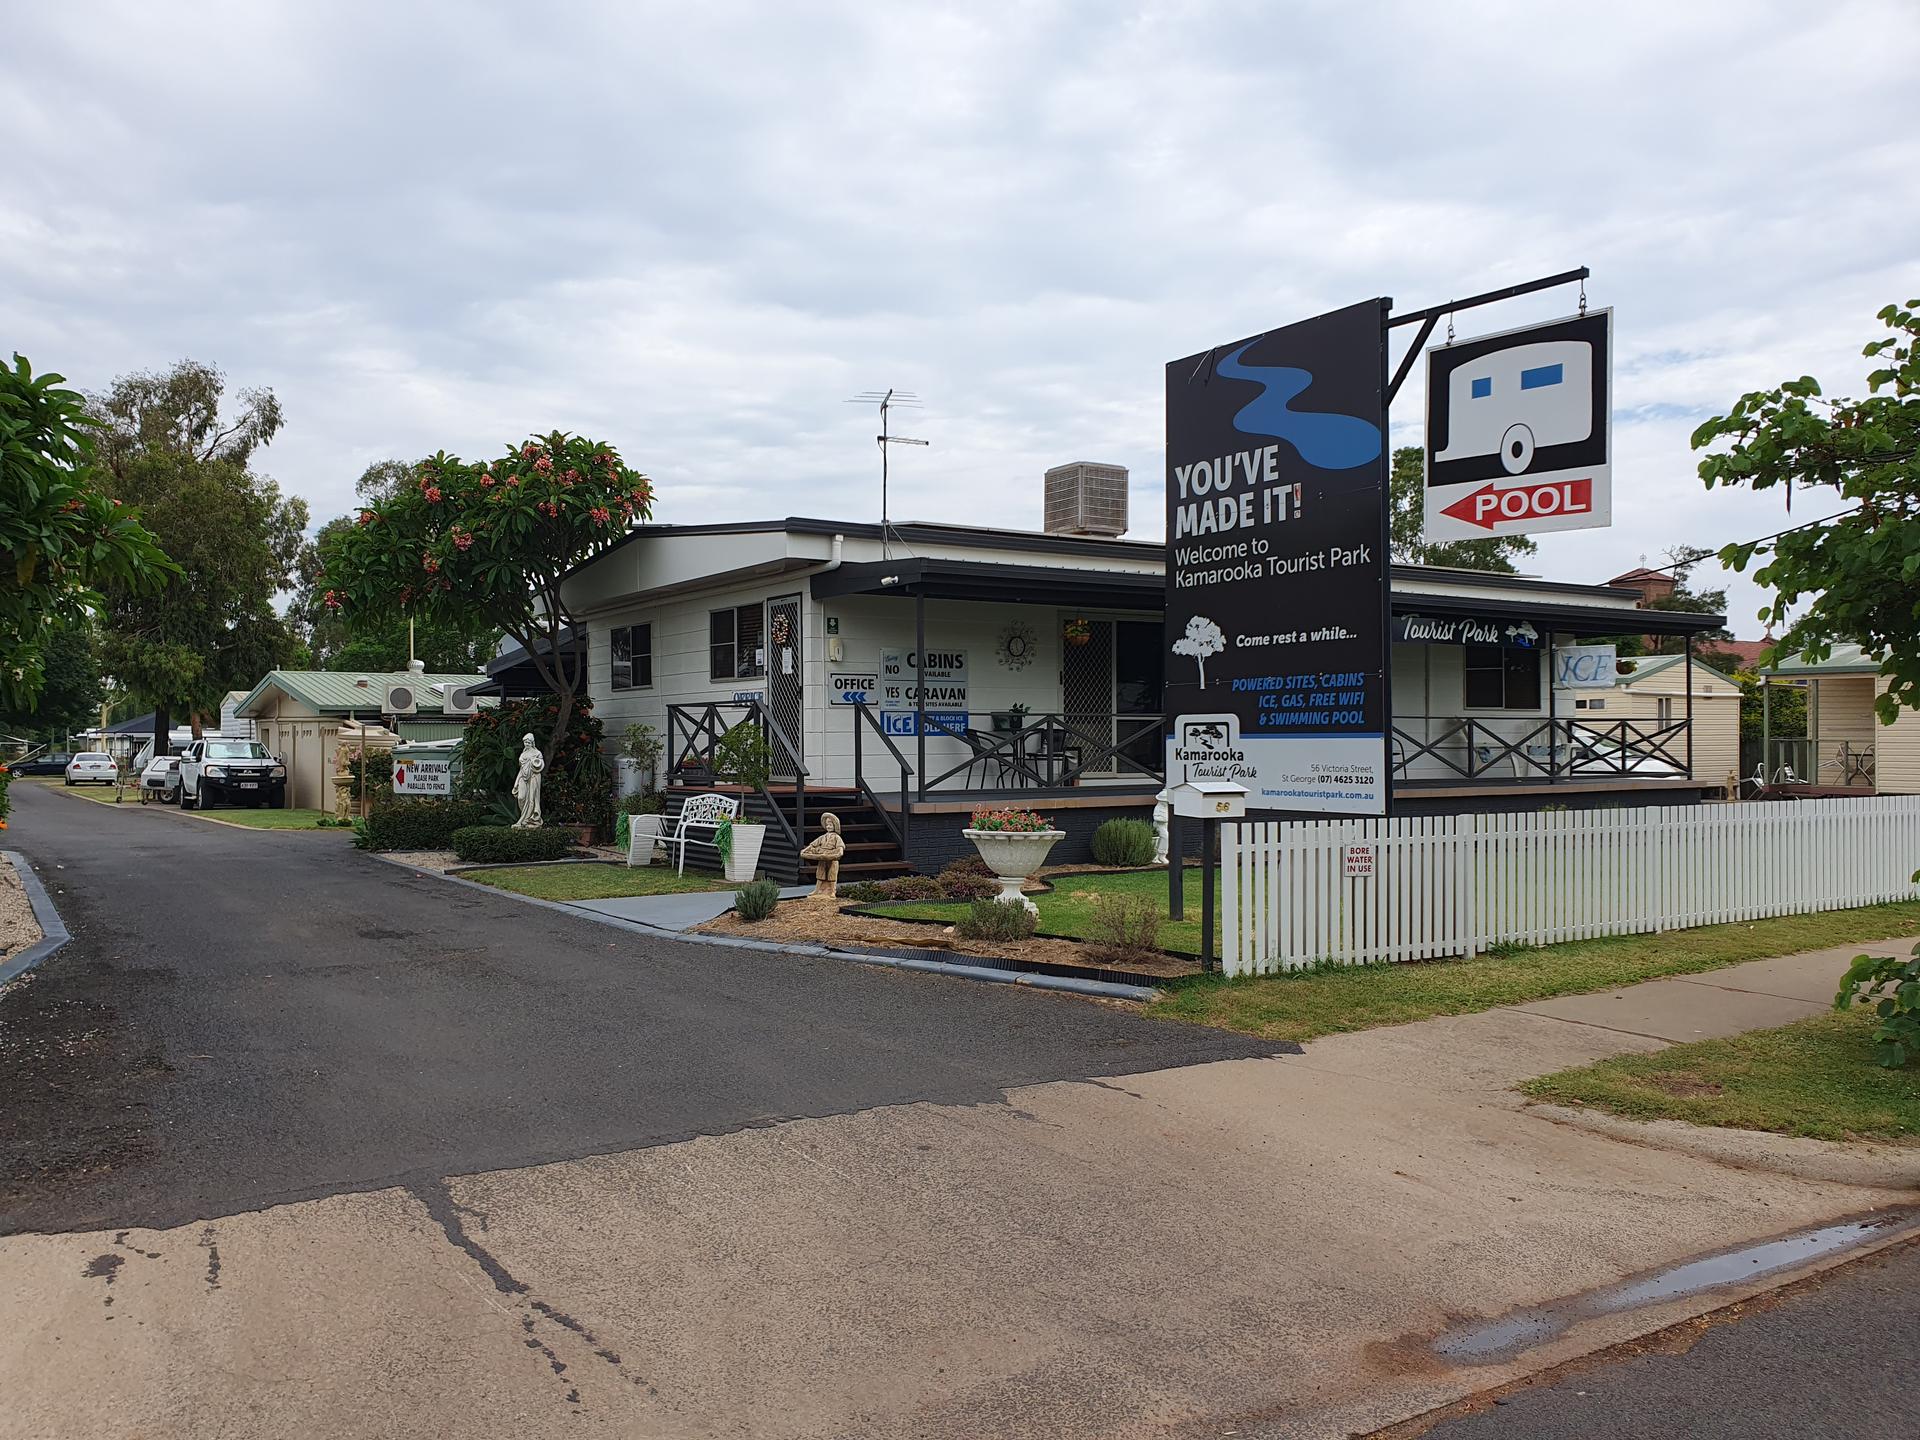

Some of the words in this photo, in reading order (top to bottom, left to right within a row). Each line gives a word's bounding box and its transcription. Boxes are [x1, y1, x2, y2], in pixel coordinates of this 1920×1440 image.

[1174, 444, 1279, 499] YOU'VE
[1475, 484, 1586, 521] POOL
[1175, 492, 1255, 540] MADE
[1263, 482, 1302, 524] IT!
[1175, 543, 1247, 566] Welcome
[1252, 537, 1269, 555] to
[1175, 561, 1263, 588] Kamarooka
[1266, 551, 1325, 576] Tourist
[1330, 544, 1371, 567] Park
[1400, 613, 1456, 640] Tourist
[1458, 618, 1499, 644] Park
[1235, 634, 1270, 647] Come
[1272, 630, 1297, 645] rest
[1299, 632, 1307, 642] a
[1310, 626, 1357, 641] while...
[885, 664, 900, 675] NO
[1560, 654, 1613, 682] ICE
[834, 678, 875, 690] OFFICE
[1231, 677, 1283, 691] POWERED
[1285, 675, 1319, 690] SITES,
[1321, 672, 1365, 688] CABINS
[885, 686, 900, 698] YES
[905, 687, 966, 700] CARAVAN
[1259, 695, 1279, 709] ICE,
[1281, 694, 1306, 709] GAS,
[1309, 693, 1337, 706] FREE
[1339, 691, 1365, 705] WIFI
[885, 714, 913, 733] ICE
[1259, 712, 1267, 726] &
[1268, 711, 1329, 726] SWIMMING
[1331, 710, 1365, 724] POOL
[1175, 748, 1244, 761] Kamarooka
[420, 763, 448, 774] ARRIVALS
[1192, 762, 1228, 777] Tourist
[1228, 763, 1257, 779] Park
[1310, 763, 1320, 772] 56
[1321, 764, 1349, 773] Victoria
[1350, 764, 1374, 774] Street,
[1281, 774, 1289, 782] St
[1289, 774, 1316, 784] George
[1317, 775, 1332, 784] (07)
[1333, 775, 1353, 784] 4625
[1354, 776, 1374, 785] 3120
[1261, 787, 1374, 800] kamarookatouristpark.com.au
[1215, 801, 1231, 813] 56
[1350, 847, 1370, 855] BORE
[1346, 856, 1373, 864] WATER
[1358, 865, 1372, 873] USE
